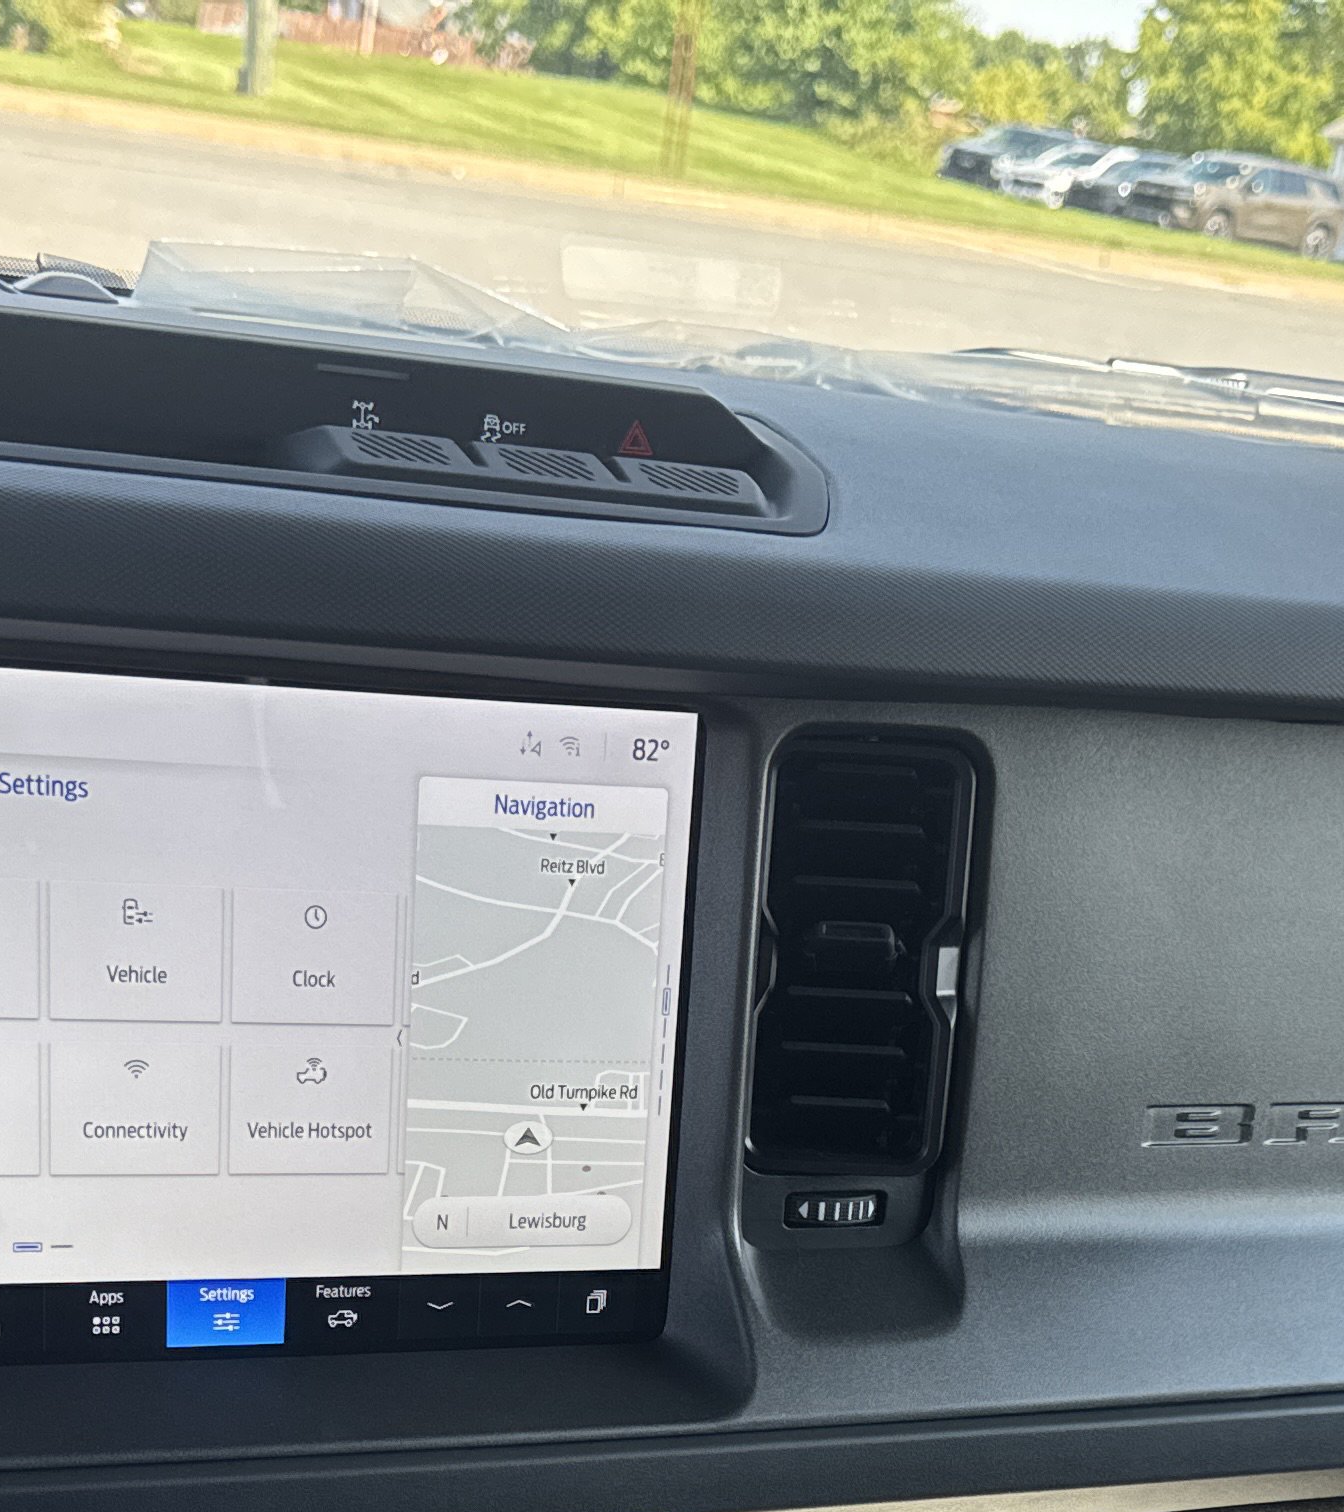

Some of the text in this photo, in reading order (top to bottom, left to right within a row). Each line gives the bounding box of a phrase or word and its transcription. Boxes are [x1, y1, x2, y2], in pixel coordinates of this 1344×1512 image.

[502, 421, 527, 436] OFF
[632, 738, 671, 762] 82°
[494, 794, 595, 820] Navigation
[540, 858, 605, 876] Reitz Blvd
[106, 964, 168, 985] Vehicle
[292, 969, 336, 989] Clock
[530, 1084, 639, 1104] Old Turnpike Rd
[82, 1121, 188, 1142] Connectivity
[247, 1122, 372, 1143] Vehicle Hotspot
[436, 1214, 448, 1230] N
[508, 1212, 586, 1232] Lewisburg
[89, 1289, 124, 1306] Apps
[198, 1284, 255, 1303] Settings
[316, 1282, 371, 1299] Features
